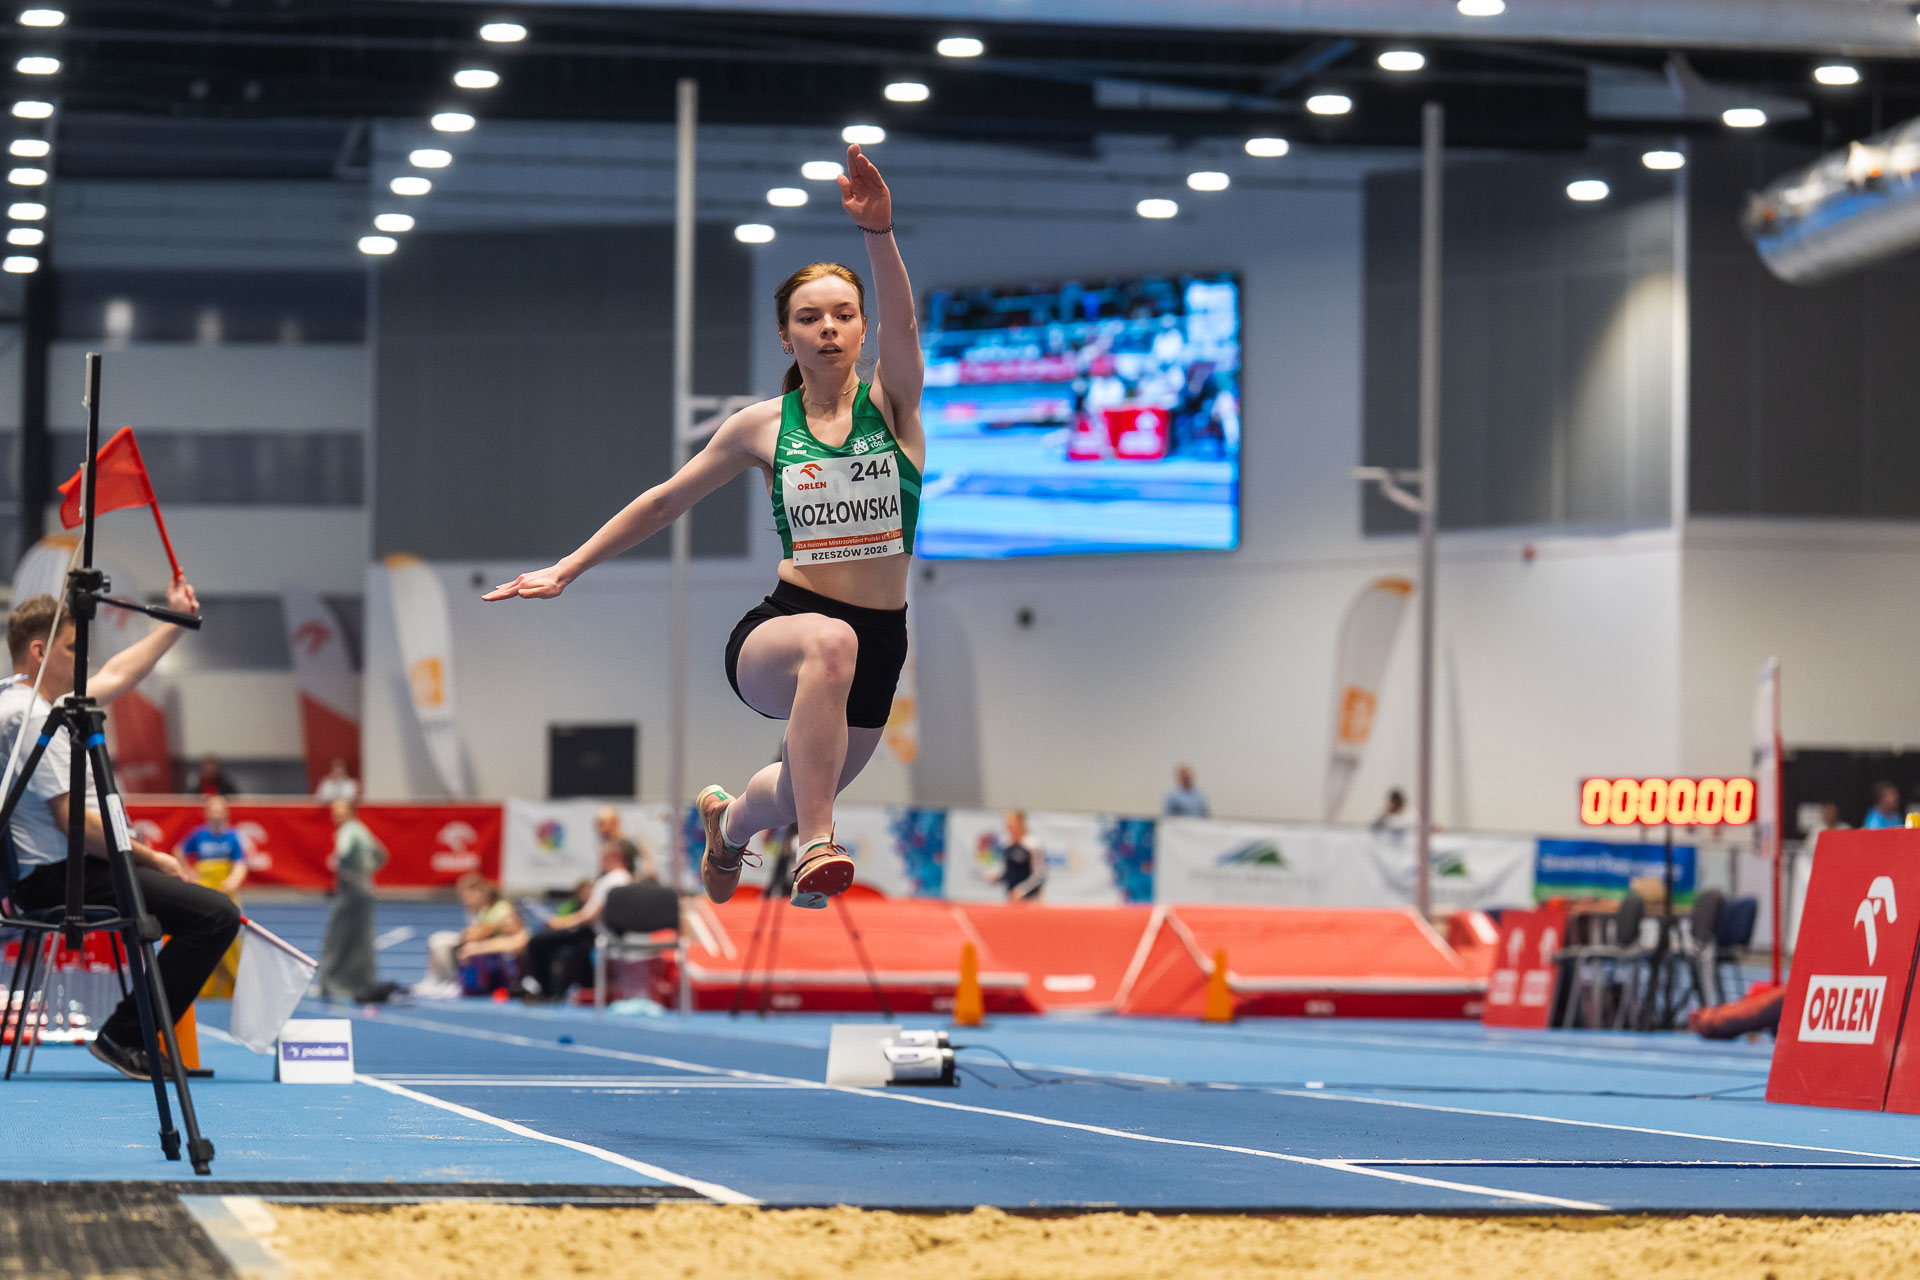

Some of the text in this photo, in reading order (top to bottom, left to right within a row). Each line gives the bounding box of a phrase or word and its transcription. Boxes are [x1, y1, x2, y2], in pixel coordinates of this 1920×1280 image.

[850, 458, 891, 482] 244
[797, 481, 827, 491] ORLEN
[789, 494, 899, 528] KOZŁOWSKA
[828, 537, 864, 546] Mistrzostwa
[864, 535, 881, 543] Polski
[811, 545, 888, 561] RZESZÓW 2026
[1807, 986, 1880, 1032] ORLEN
